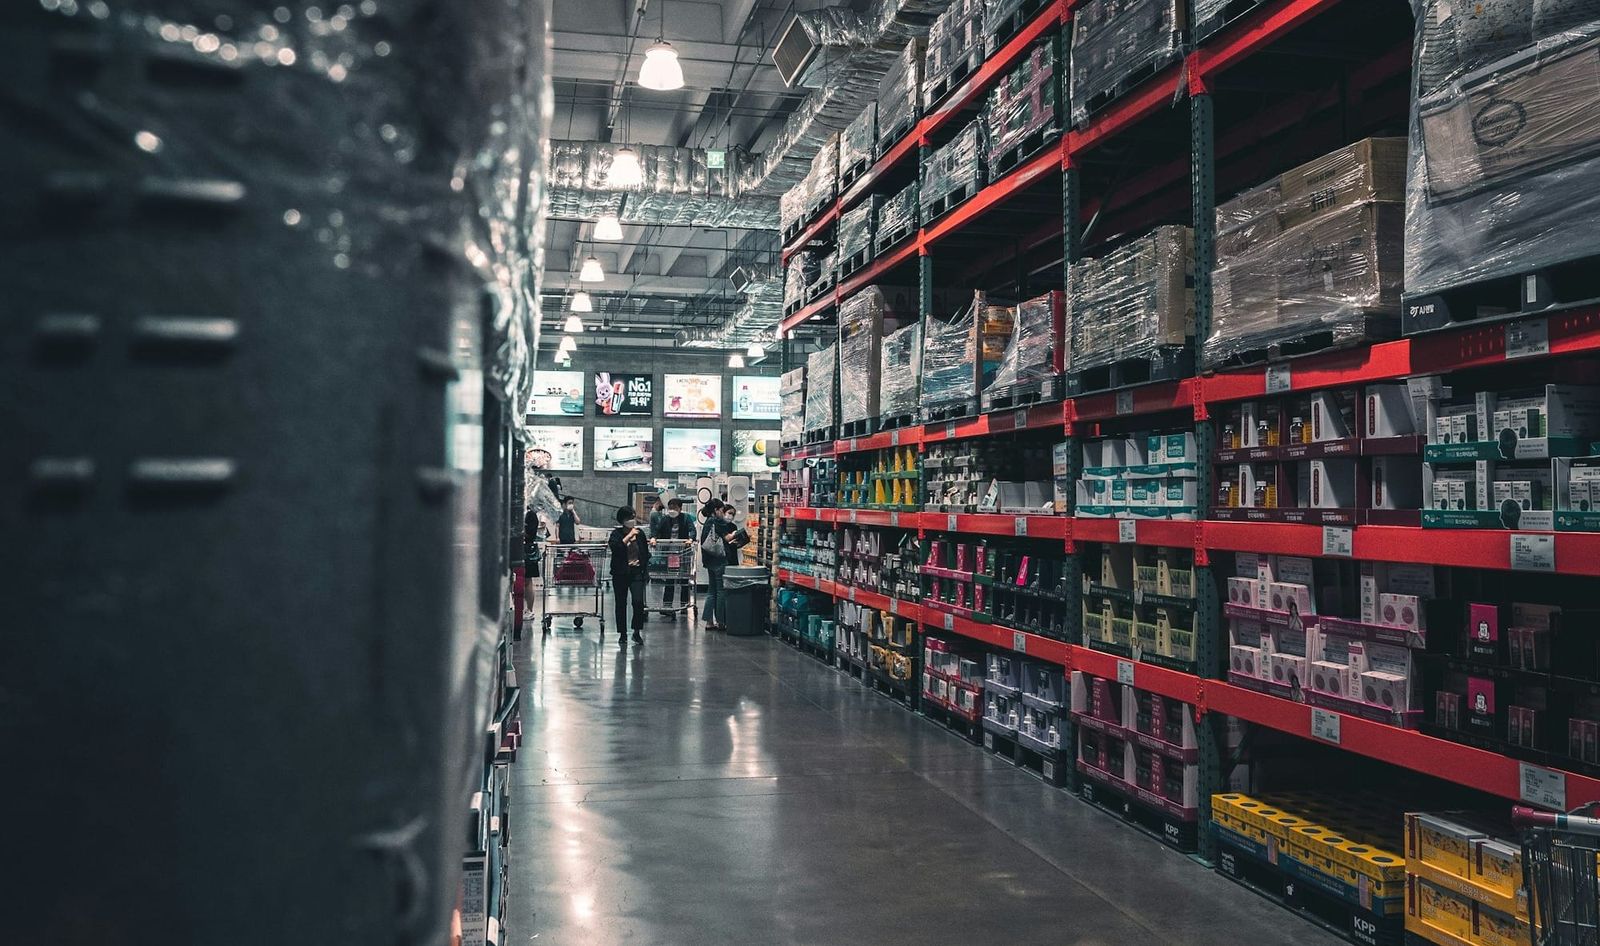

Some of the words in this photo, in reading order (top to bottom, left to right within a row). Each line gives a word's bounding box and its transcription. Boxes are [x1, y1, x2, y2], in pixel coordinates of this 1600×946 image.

[628, 380, 651, 392] No.1
[1165, 822, 1179, 836] KPP
[1354, 916, 1376, 935] KPP
